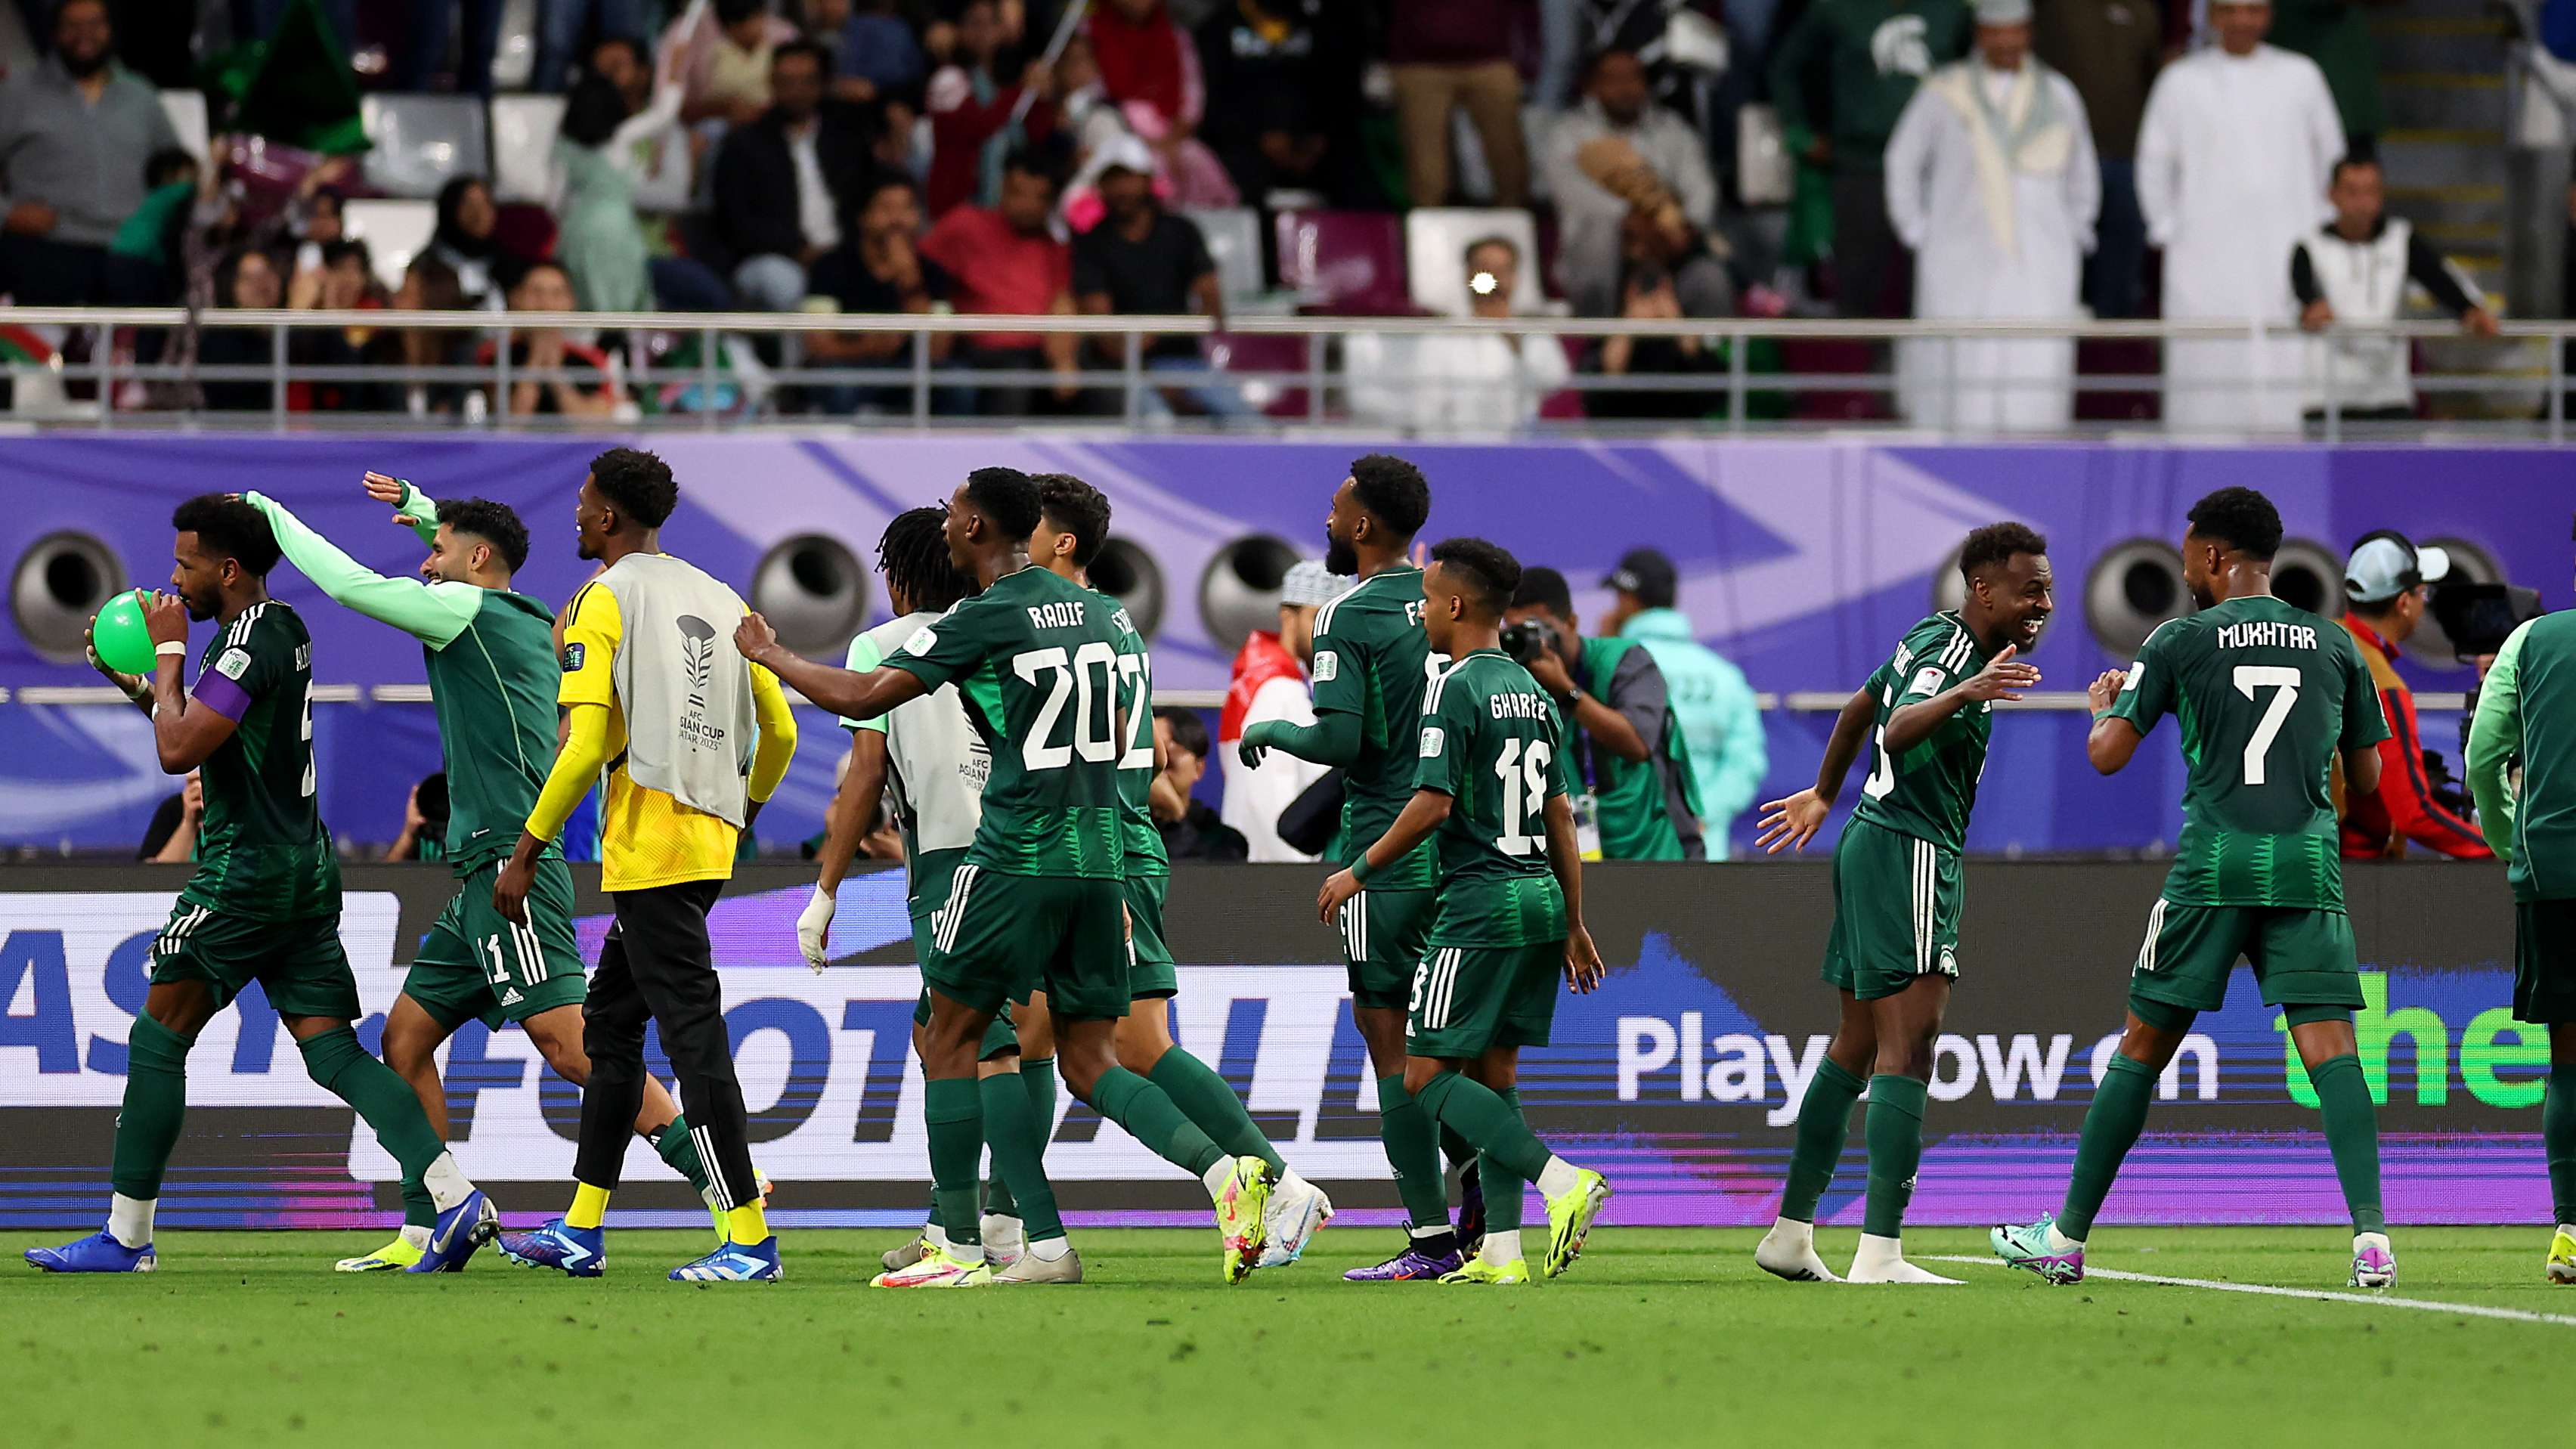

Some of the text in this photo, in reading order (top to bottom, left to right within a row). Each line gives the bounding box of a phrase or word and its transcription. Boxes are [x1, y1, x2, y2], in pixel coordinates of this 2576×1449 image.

[1027, 602, 1084, 629] RADIF
[2218, 621, 2317, 650] MUKHTAR
[689, 710, 702, 721] AFC
[1013, 642, 1116, 771] 20
[679, 730, 697, 744] ATAR
[680, 716, 725, 740] SIAN CUP
[2233, 665, 2302, 785] 7
[959, 763, 985, 782] ASIAN
[972, 759, 988, 769] AFC
[501, 995, 525, 1007] adidas
[1618, 1011, 1831, 1126] Play
[1857, 1034, 2072, 1101] ow
